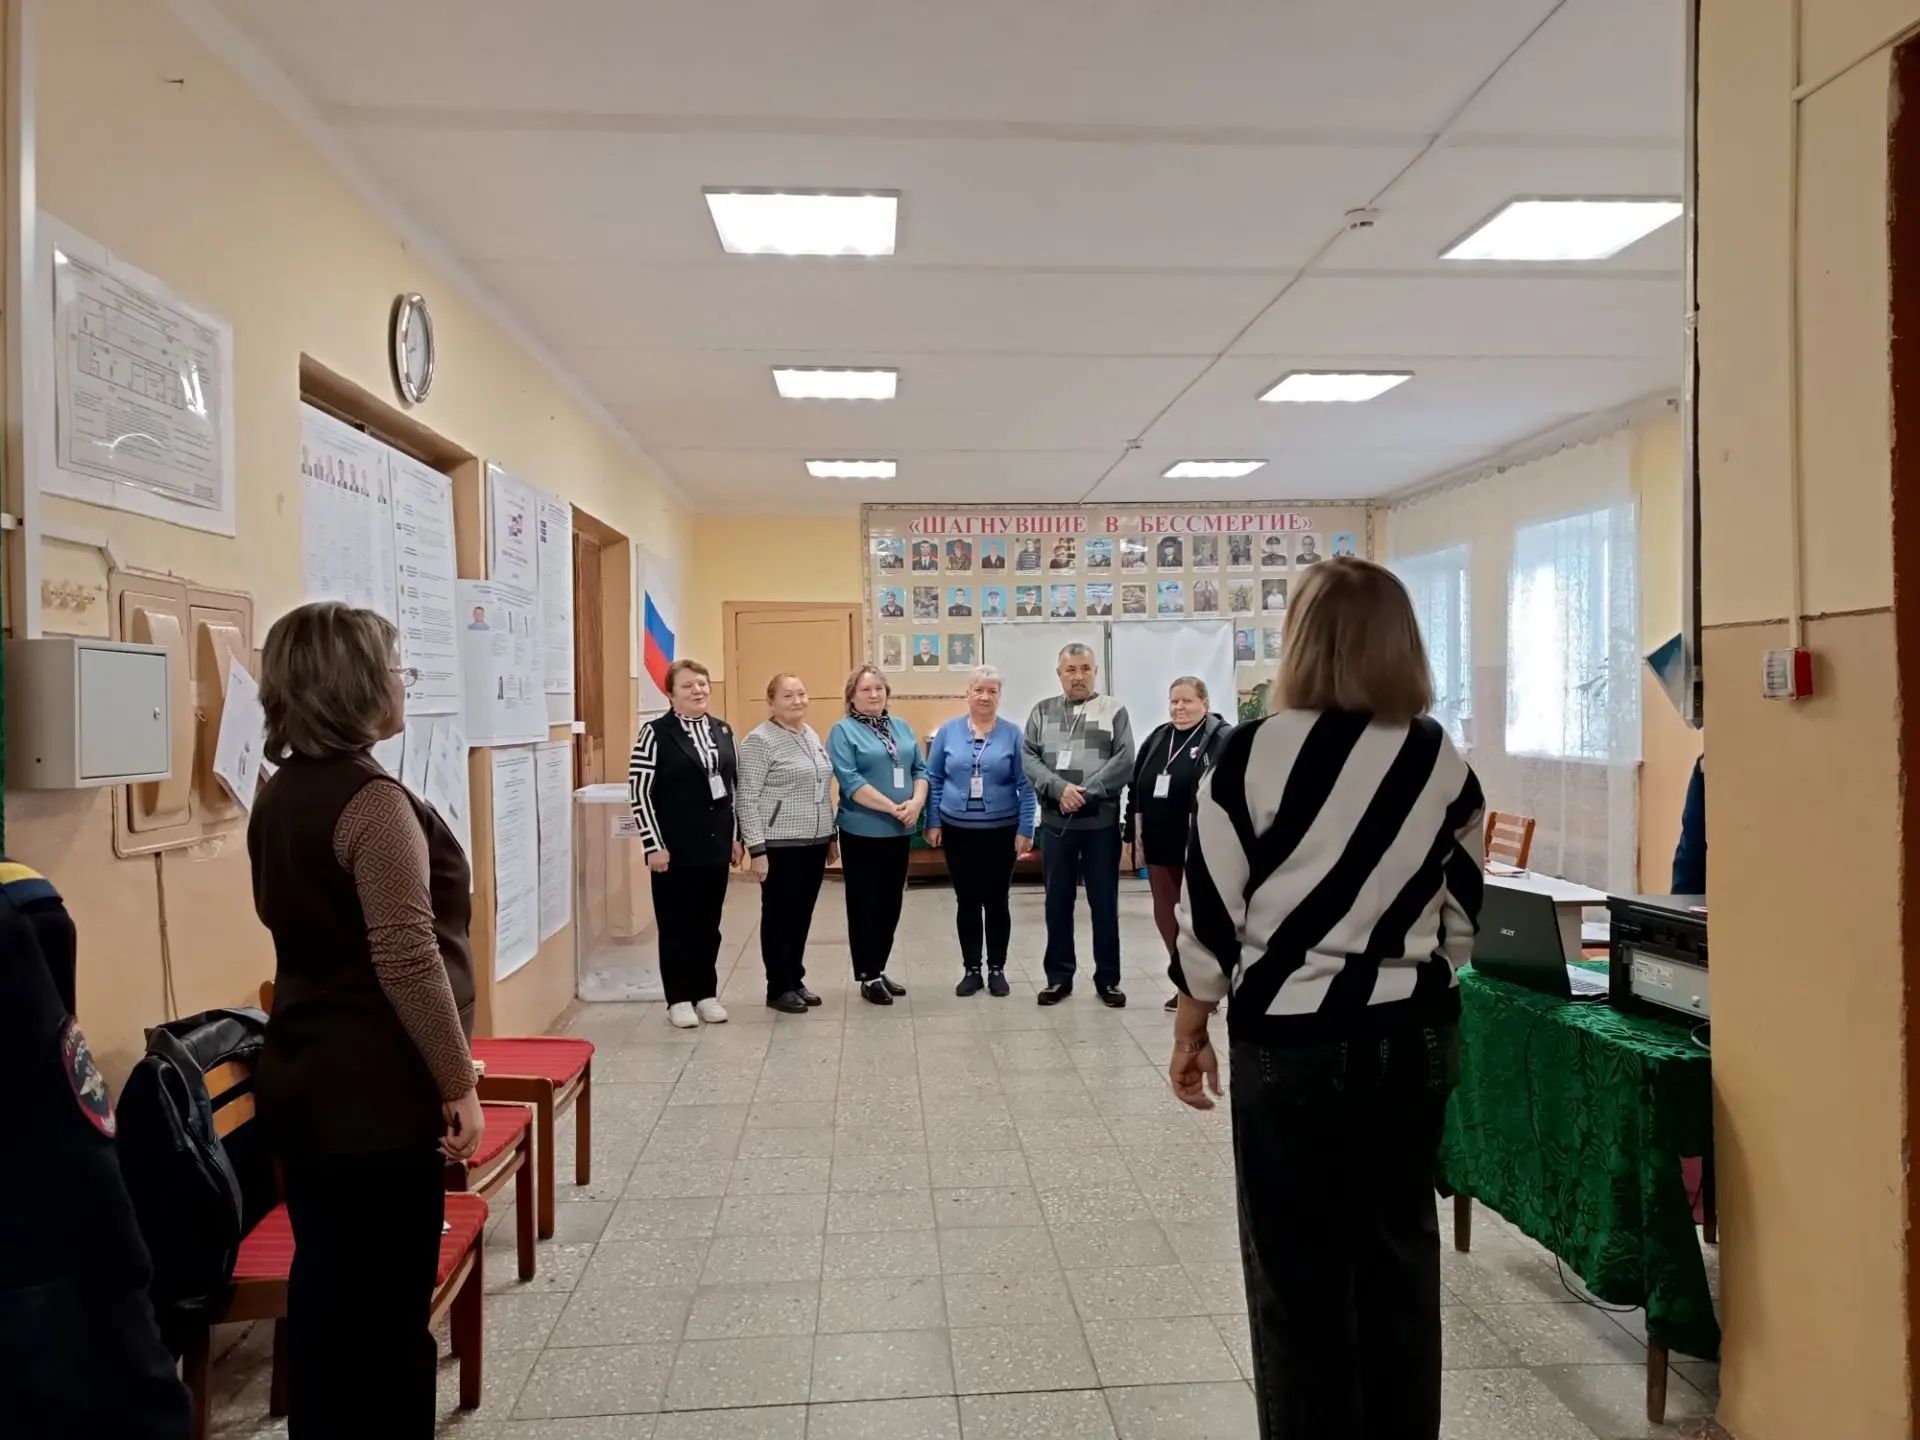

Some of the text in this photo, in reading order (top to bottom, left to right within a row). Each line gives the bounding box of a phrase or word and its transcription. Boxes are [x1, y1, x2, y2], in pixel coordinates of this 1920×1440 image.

[908, 514, 1313, 534] «ШАГНУВШИЕ В БЕССМЕРТИЕ»
[1500, 928, 1515, 936] acer
